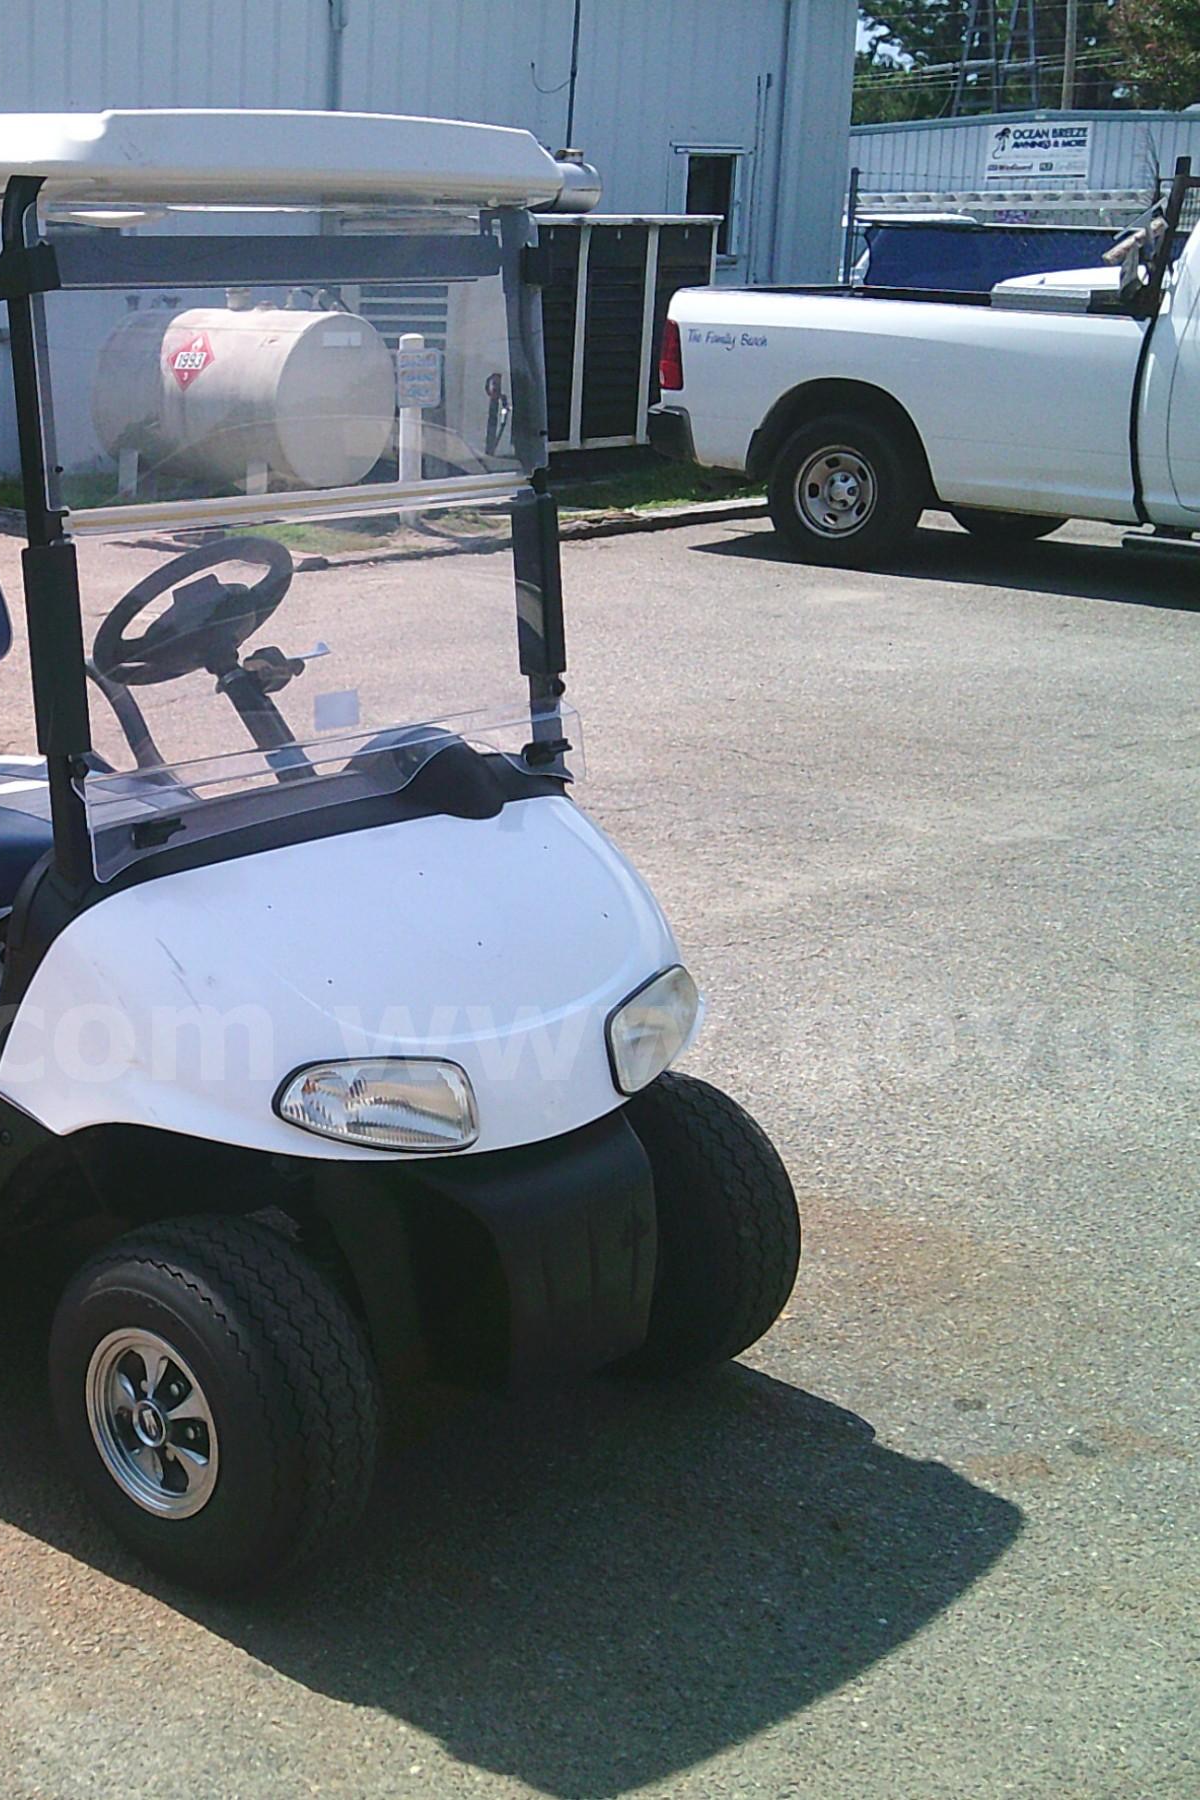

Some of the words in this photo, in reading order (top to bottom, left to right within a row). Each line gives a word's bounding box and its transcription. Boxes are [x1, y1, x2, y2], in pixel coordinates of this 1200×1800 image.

[1013, 128, 1050, 139] OCEAN
[1052, 127, 1088, 138] BREEZE
[1061, 139, 1087, 147] MORE
[178, 353, 204, 368] 1993
